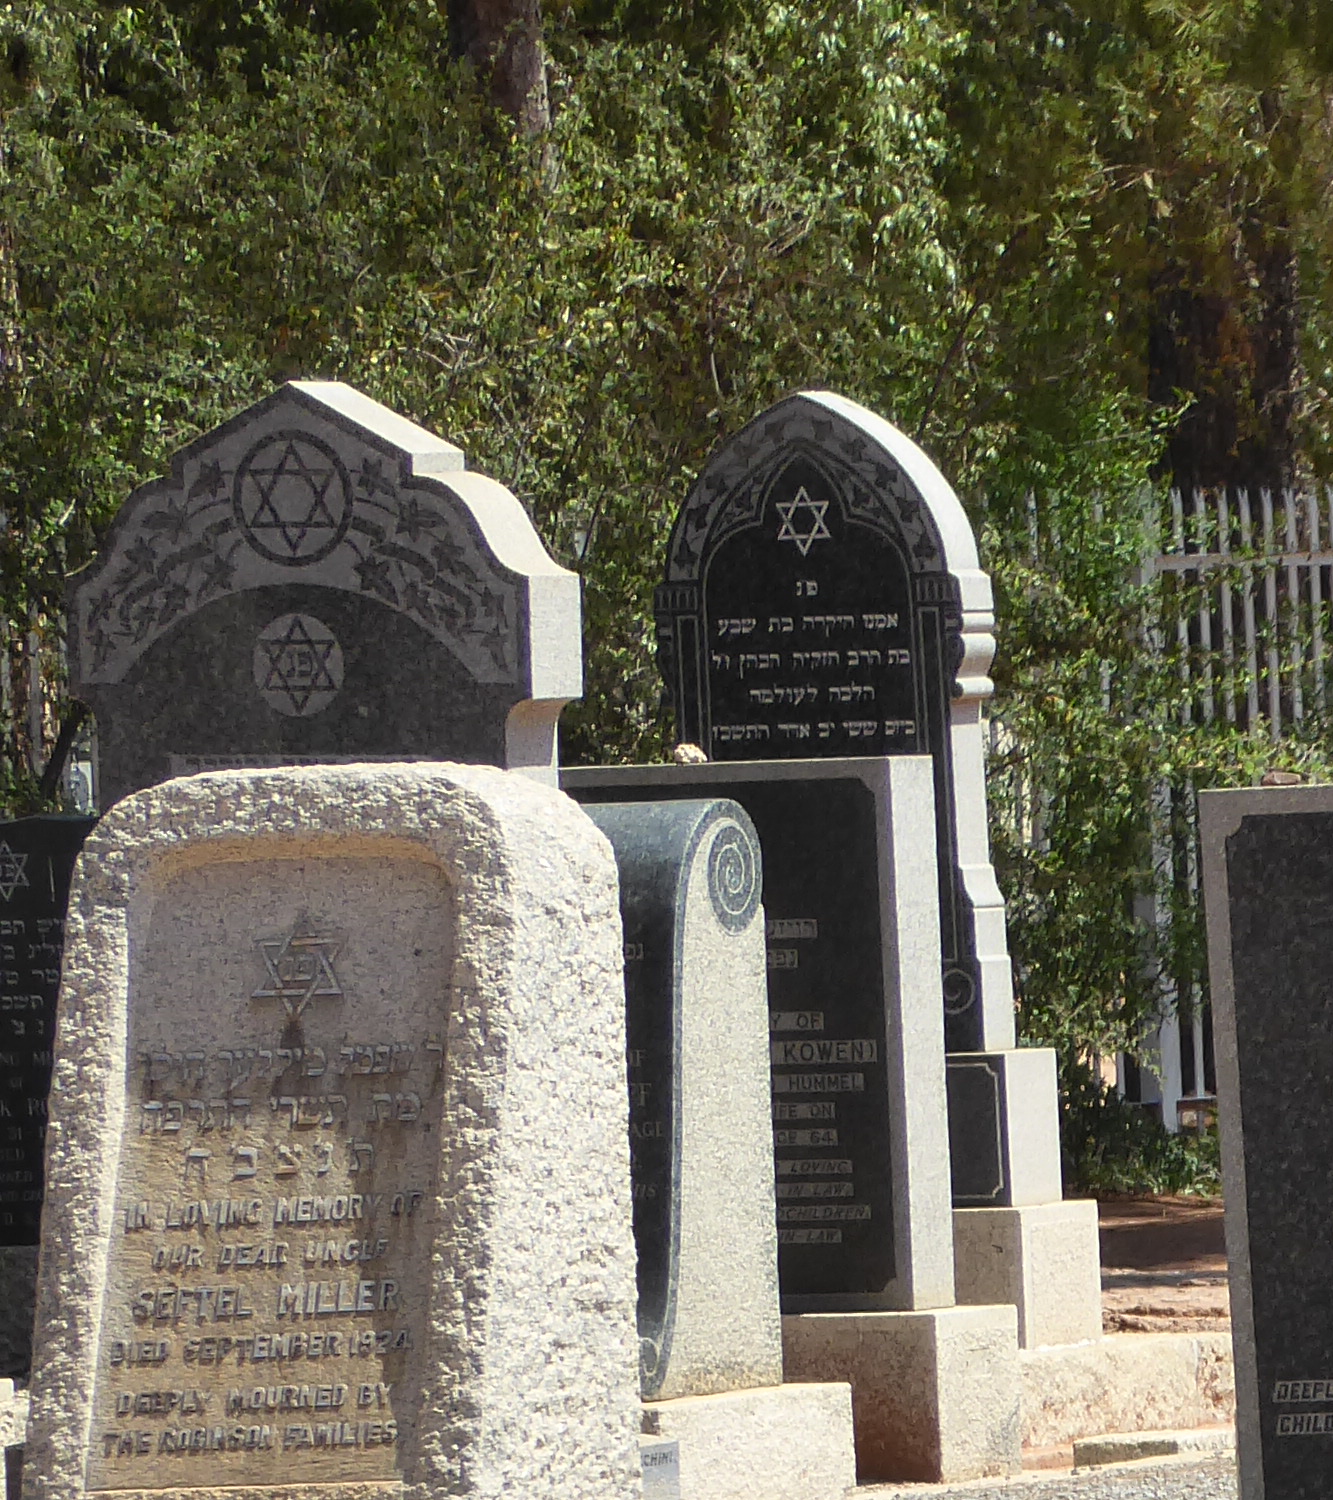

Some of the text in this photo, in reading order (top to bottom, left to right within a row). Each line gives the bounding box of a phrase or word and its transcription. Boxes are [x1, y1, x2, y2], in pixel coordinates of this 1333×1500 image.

[788, 1075, 861, 1090] HUMMEL
[126, 1191, 424, 1229] IN LOVING MEMORY OF
[153, 1239, 390, 1269] OUR DEAR UNCLE
[132, 1279, 400, 1321] SEFTEL MILLER
[110, 1330, 414, 1365] DIED SEPTEMBER 1924
[116, 1382, 393, 1415] DEEPLY MOURNED BY
[103, 1420, 399, 1455] THE ROBINSON FAMILIES
